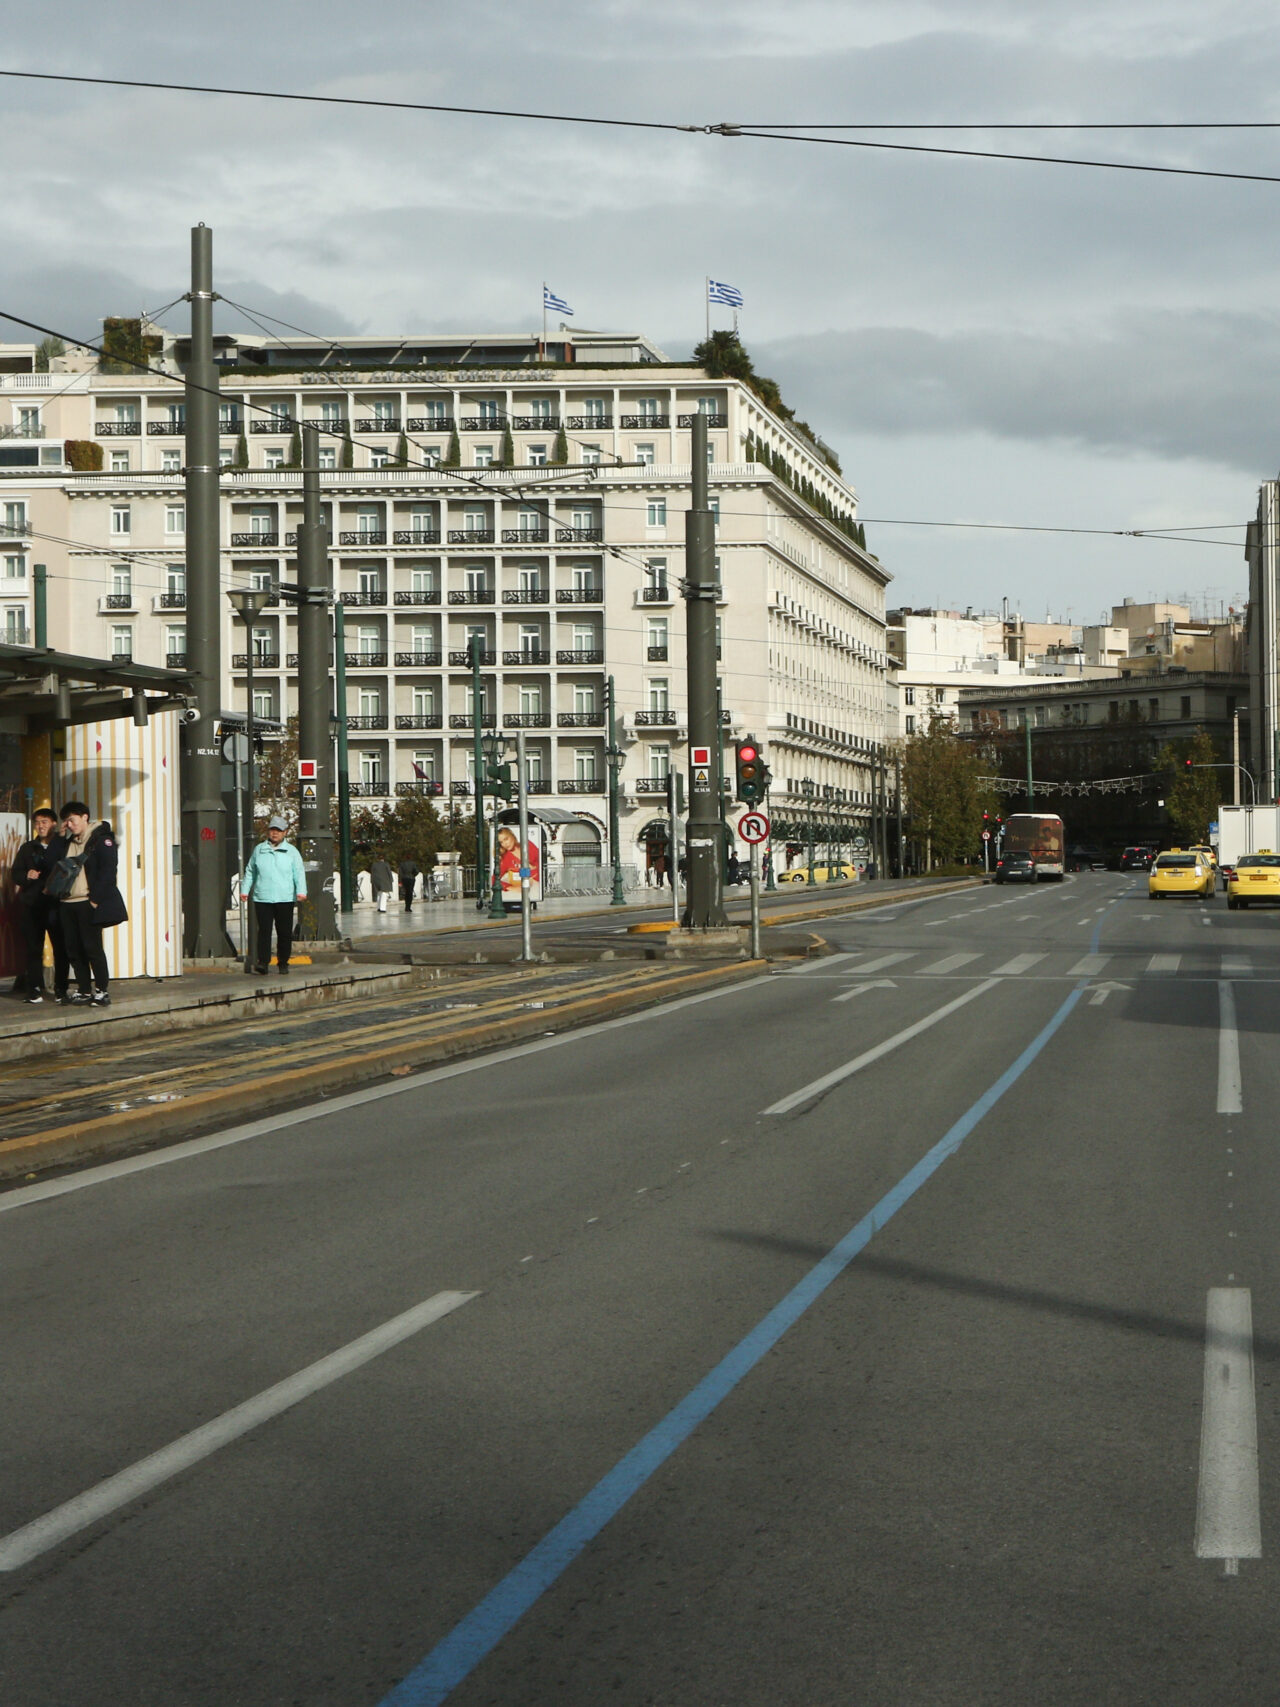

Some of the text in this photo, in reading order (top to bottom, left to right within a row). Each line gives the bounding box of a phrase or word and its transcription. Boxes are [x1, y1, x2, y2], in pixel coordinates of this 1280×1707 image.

[302, 369, 557, 384] HOTEL GRANDE BRETAGNE
